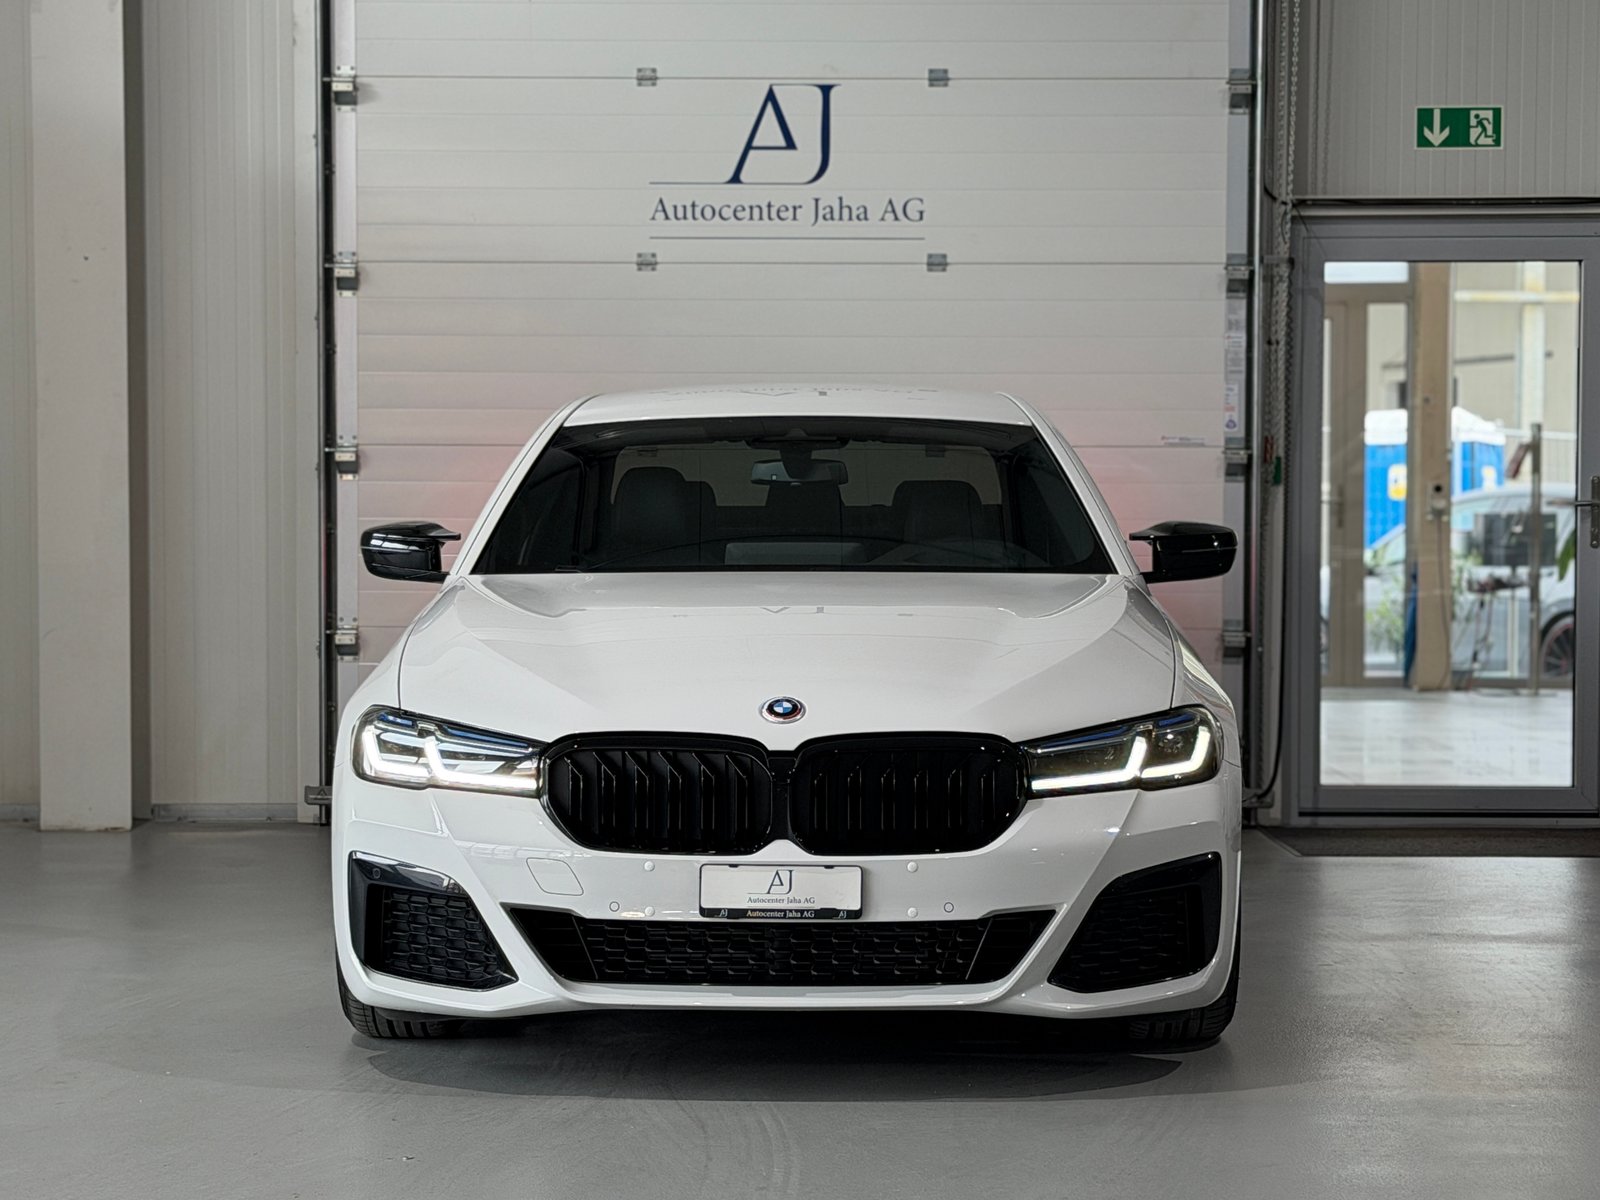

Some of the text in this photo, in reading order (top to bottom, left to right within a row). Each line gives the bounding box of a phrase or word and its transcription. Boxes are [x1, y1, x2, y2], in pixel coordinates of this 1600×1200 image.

[721, 82, 842, 185] AJ
[649, 196, 925, 227] Autocenter Jaha AG
[766, 869, 794, 895] AJ
[746, 909, 815, 918] Autocenter Jaha AG
[747, 896, 785, 904] Autocenter
[786, 896, 802, 905] Jaha
